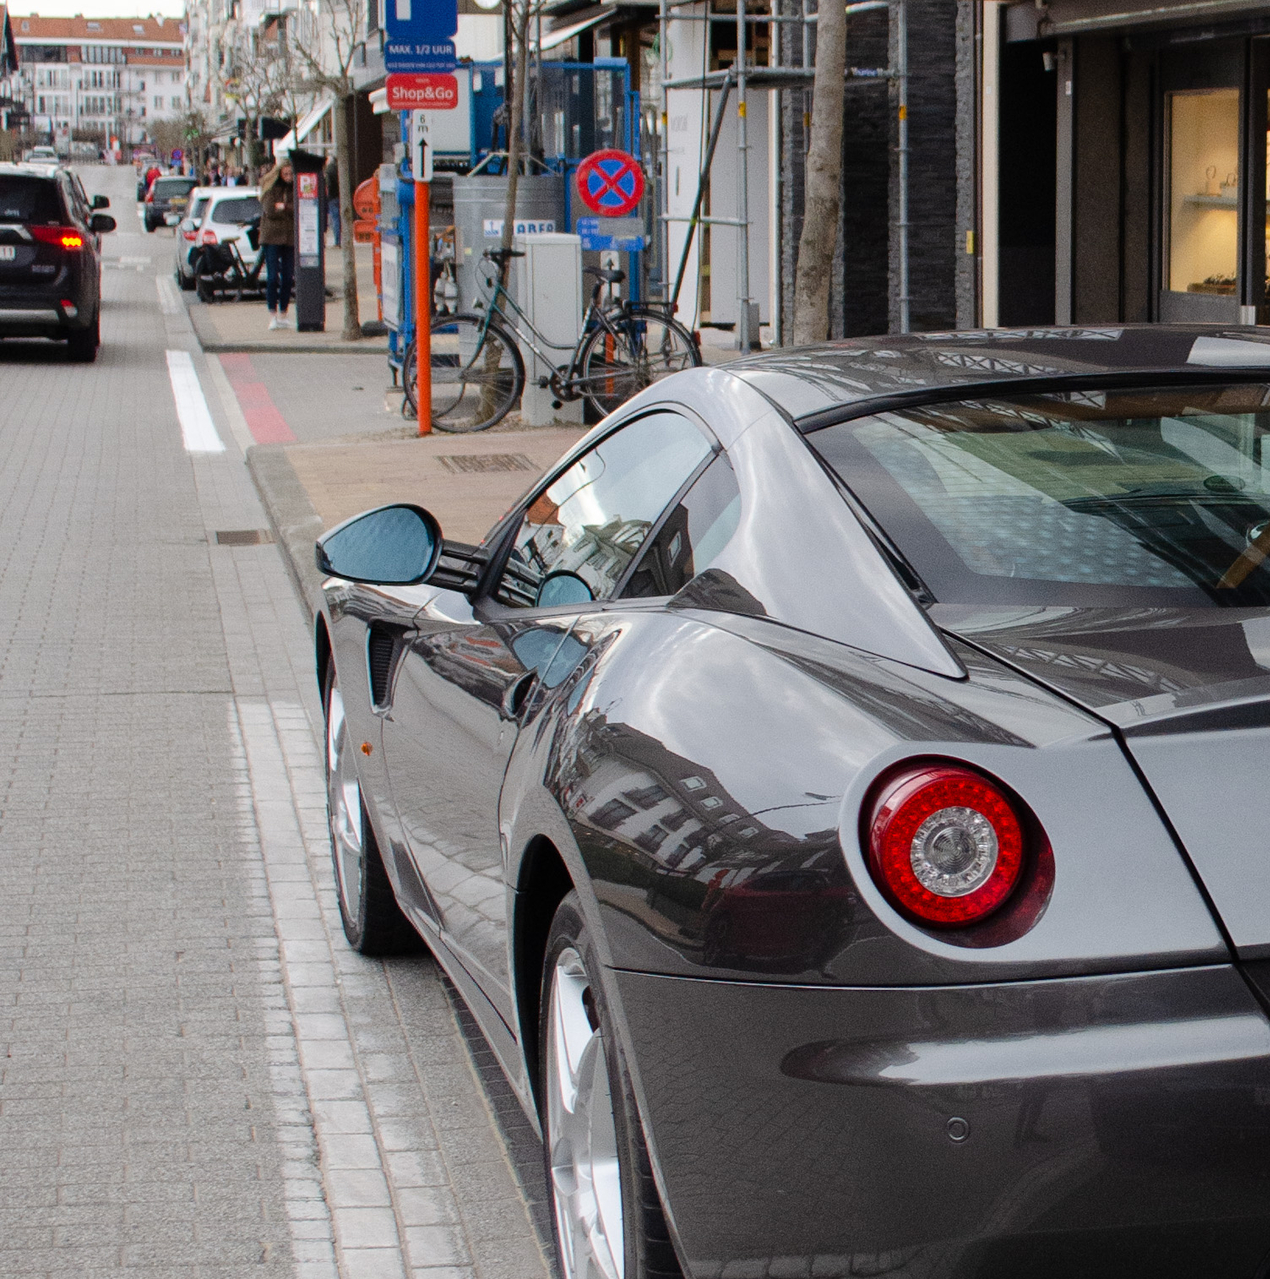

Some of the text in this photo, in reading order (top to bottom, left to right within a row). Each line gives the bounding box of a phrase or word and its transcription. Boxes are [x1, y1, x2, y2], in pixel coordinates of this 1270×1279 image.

[389, 44, 452, 56] MAX. 1/2 UUR
[392, 86, 454, 102] Shop&Go
